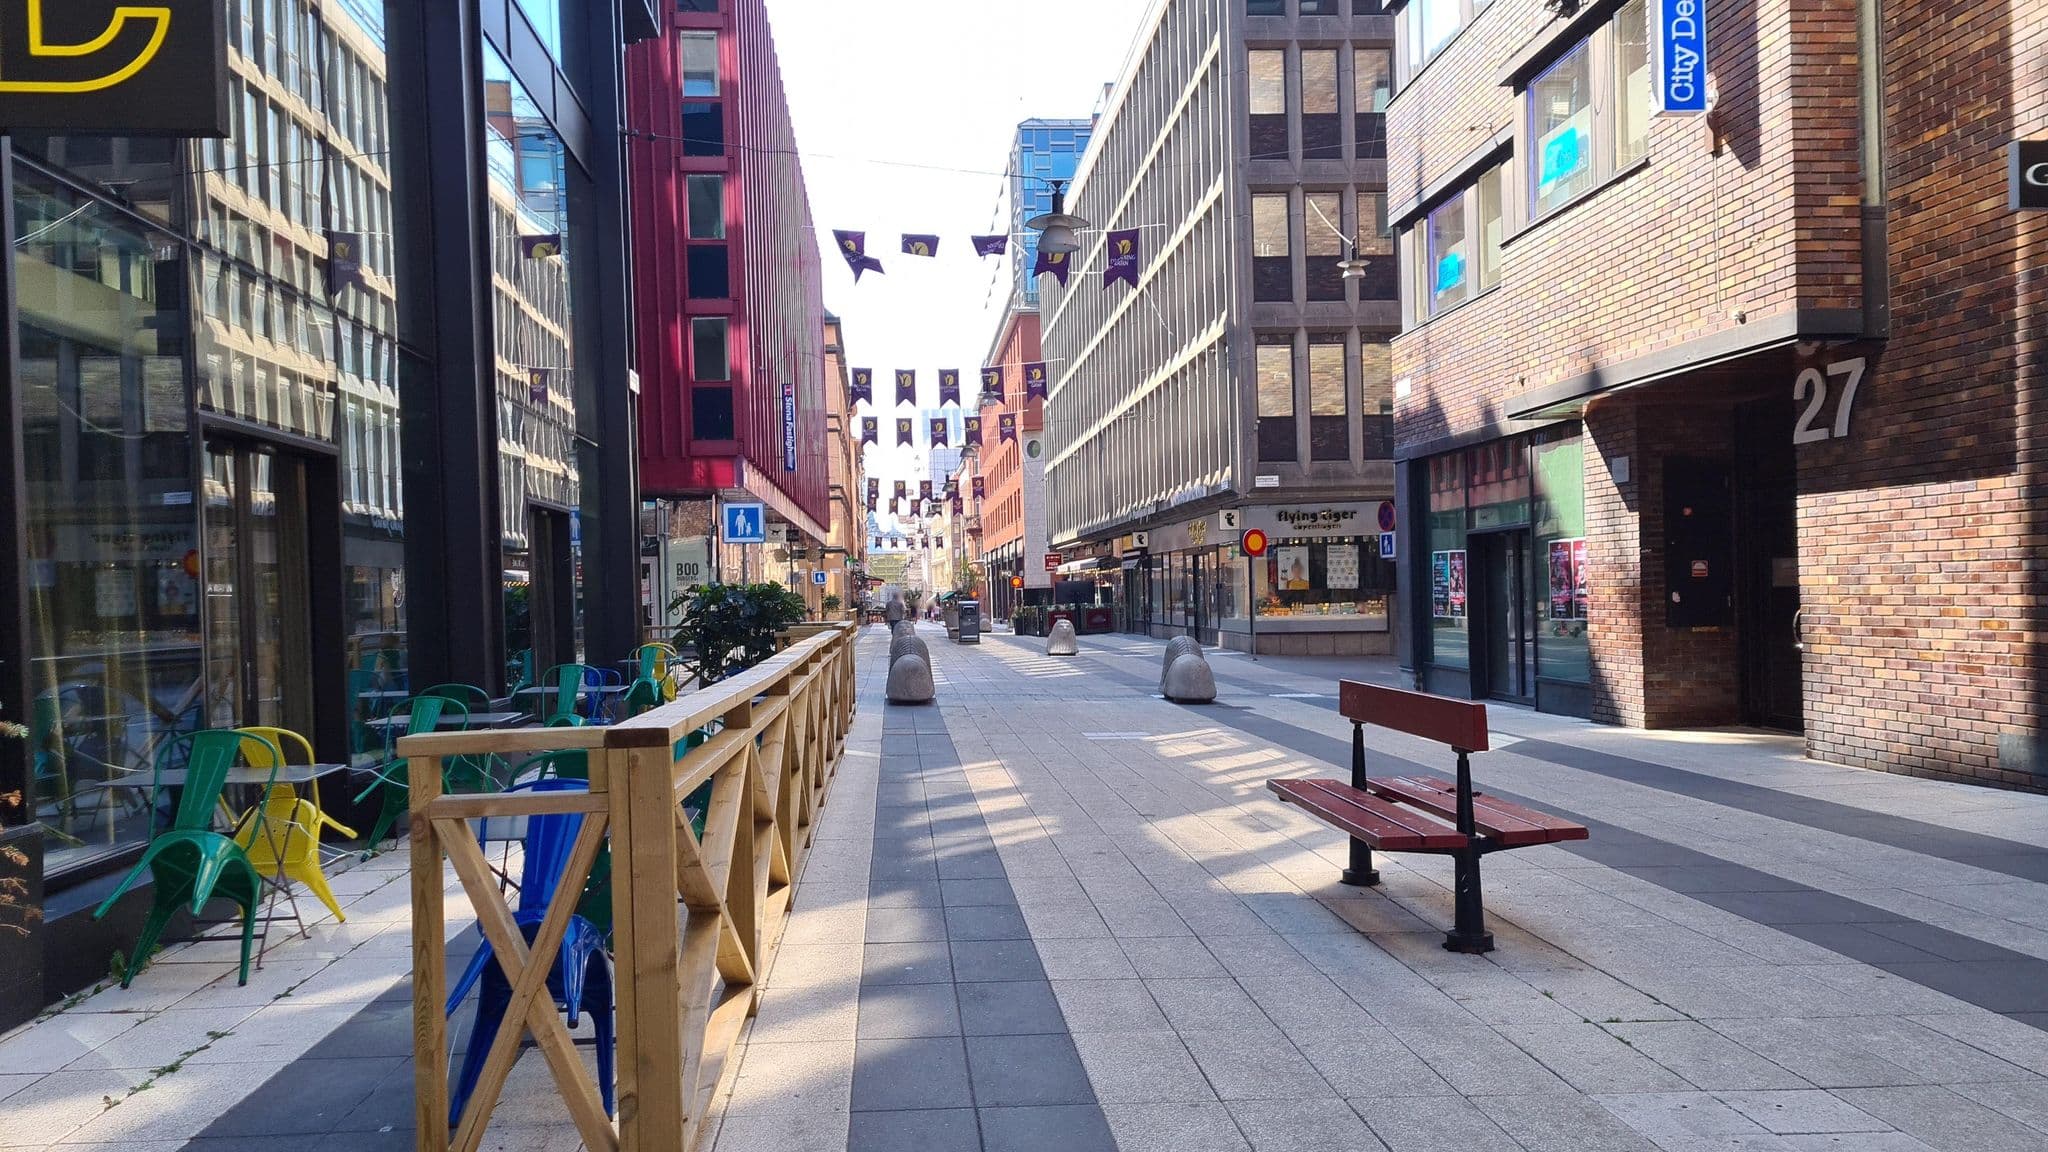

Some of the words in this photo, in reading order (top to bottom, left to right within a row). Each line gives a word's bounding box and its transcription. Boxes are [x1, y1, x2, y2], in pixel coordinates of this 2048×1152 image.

[1670, 43, 1700, 102] City
[785, 396, 793, 421] Stena
[1793, 357, 1866, 445] 27
[1277, 509, 1318, 524] flying
[1320, 509, 1357, 522] tiger
